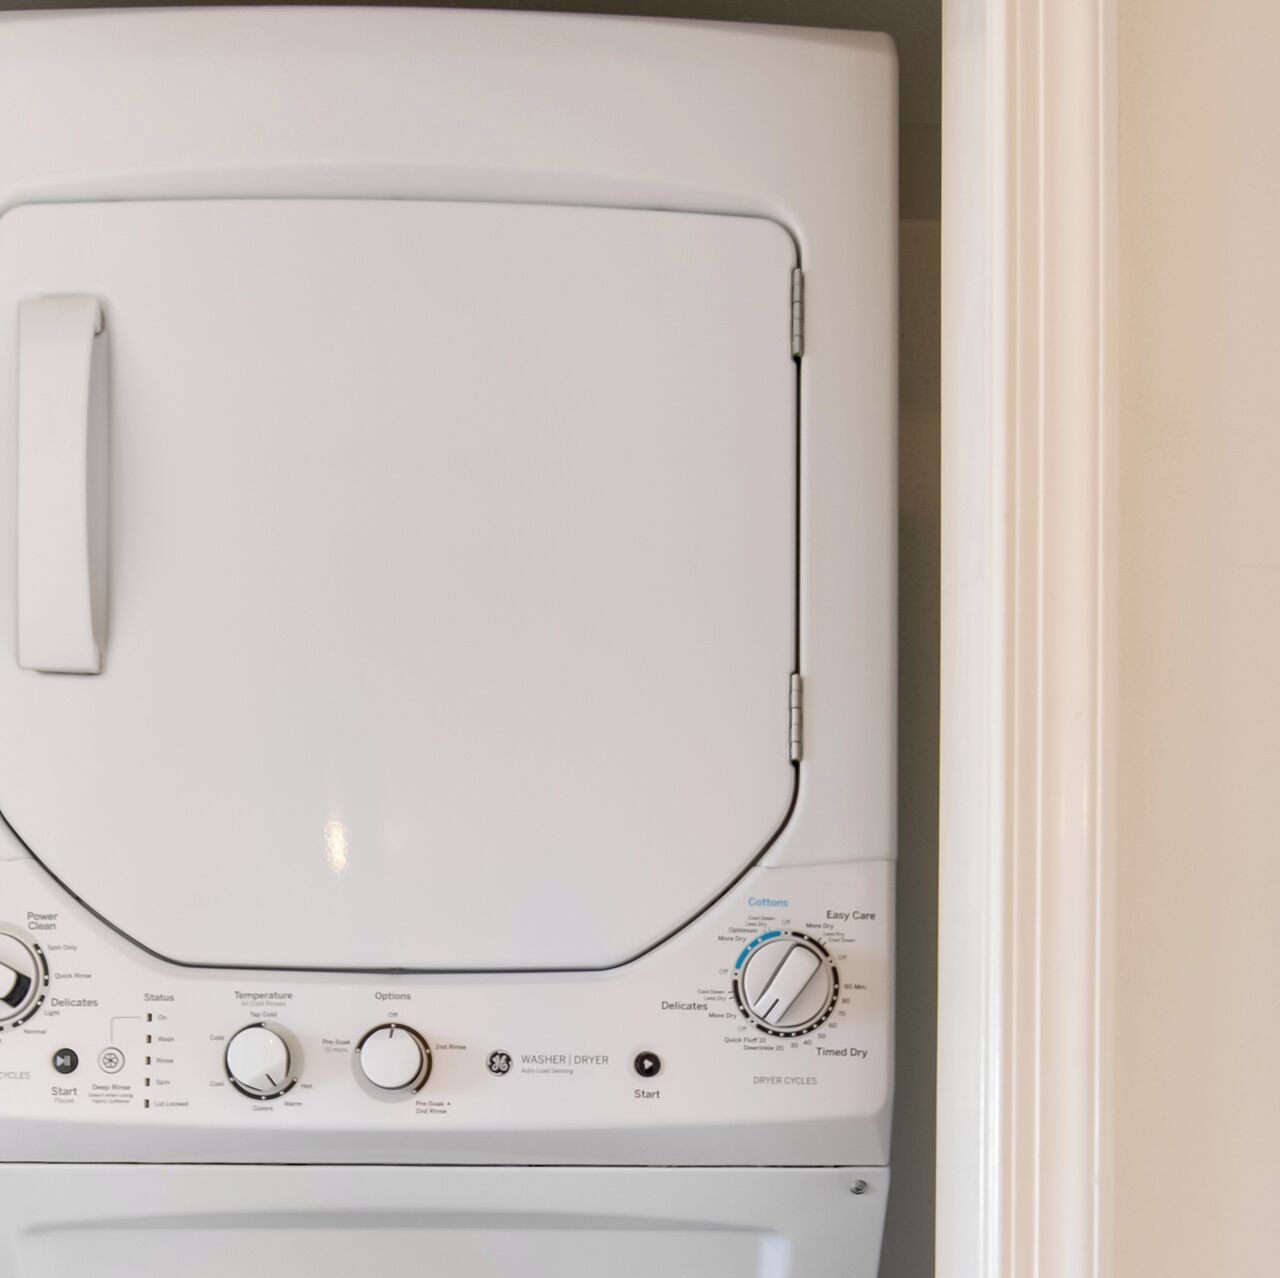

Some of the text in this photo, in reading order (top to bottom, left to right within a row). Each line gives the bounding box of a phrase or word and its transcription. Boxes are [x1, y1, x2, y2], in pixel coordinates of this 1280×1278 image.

[748, 897, 789, 908] Cottons
[27, 911, 58, 921] Power
[826, 910, 876, 921] Easy Care
[28, 921, 57, 931] Clean
[144, 993, 175, 1002] Status
[234, 990, 294, 1001] Temperature
[374, 991, 412, 1001] Options
[50, 997, 99, 1008] Delicates
[661, 1000, 709, 1011] Delicates
[816, 1046, 869, 1059] Timed Dry
[521, 1054, 610, 1065] WASHER DRYER
[752, 1075, 819, 1086] DRYER CYCLES
[50, 1086, 79, 1097] Start
[633, 1089, 661, 1099] Start
